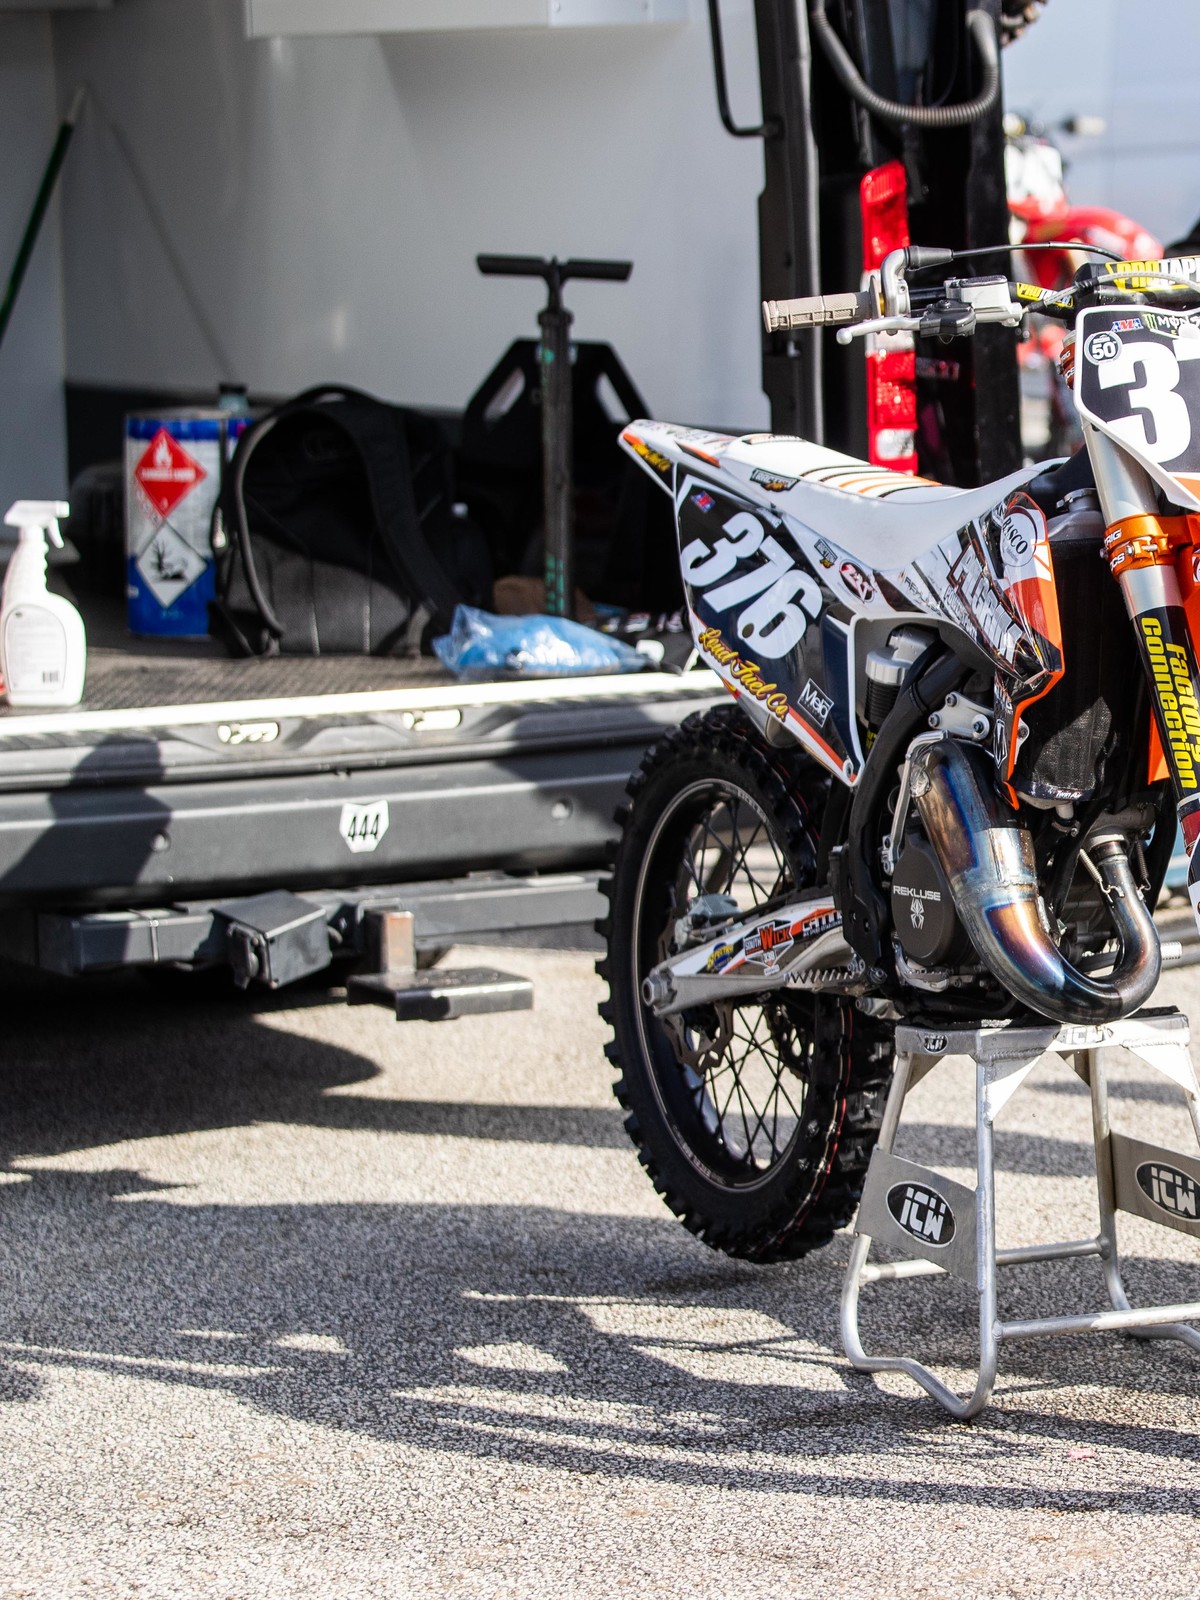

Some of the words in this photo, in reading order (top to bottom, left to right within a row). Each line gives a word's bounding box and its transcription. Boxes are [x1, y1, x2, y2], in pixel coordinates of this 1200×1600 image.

[1112, 319, 1144, 332] AMA
[1092, 341, 1117, 360] 50
[680, 511, 823, 660] 376
[698, 627, 739, 666] Loud
[730, 660, 778, 701] Fuel
[346, 812, 382, 844] 444
[892, 885, 941, 901] REKLUSE
